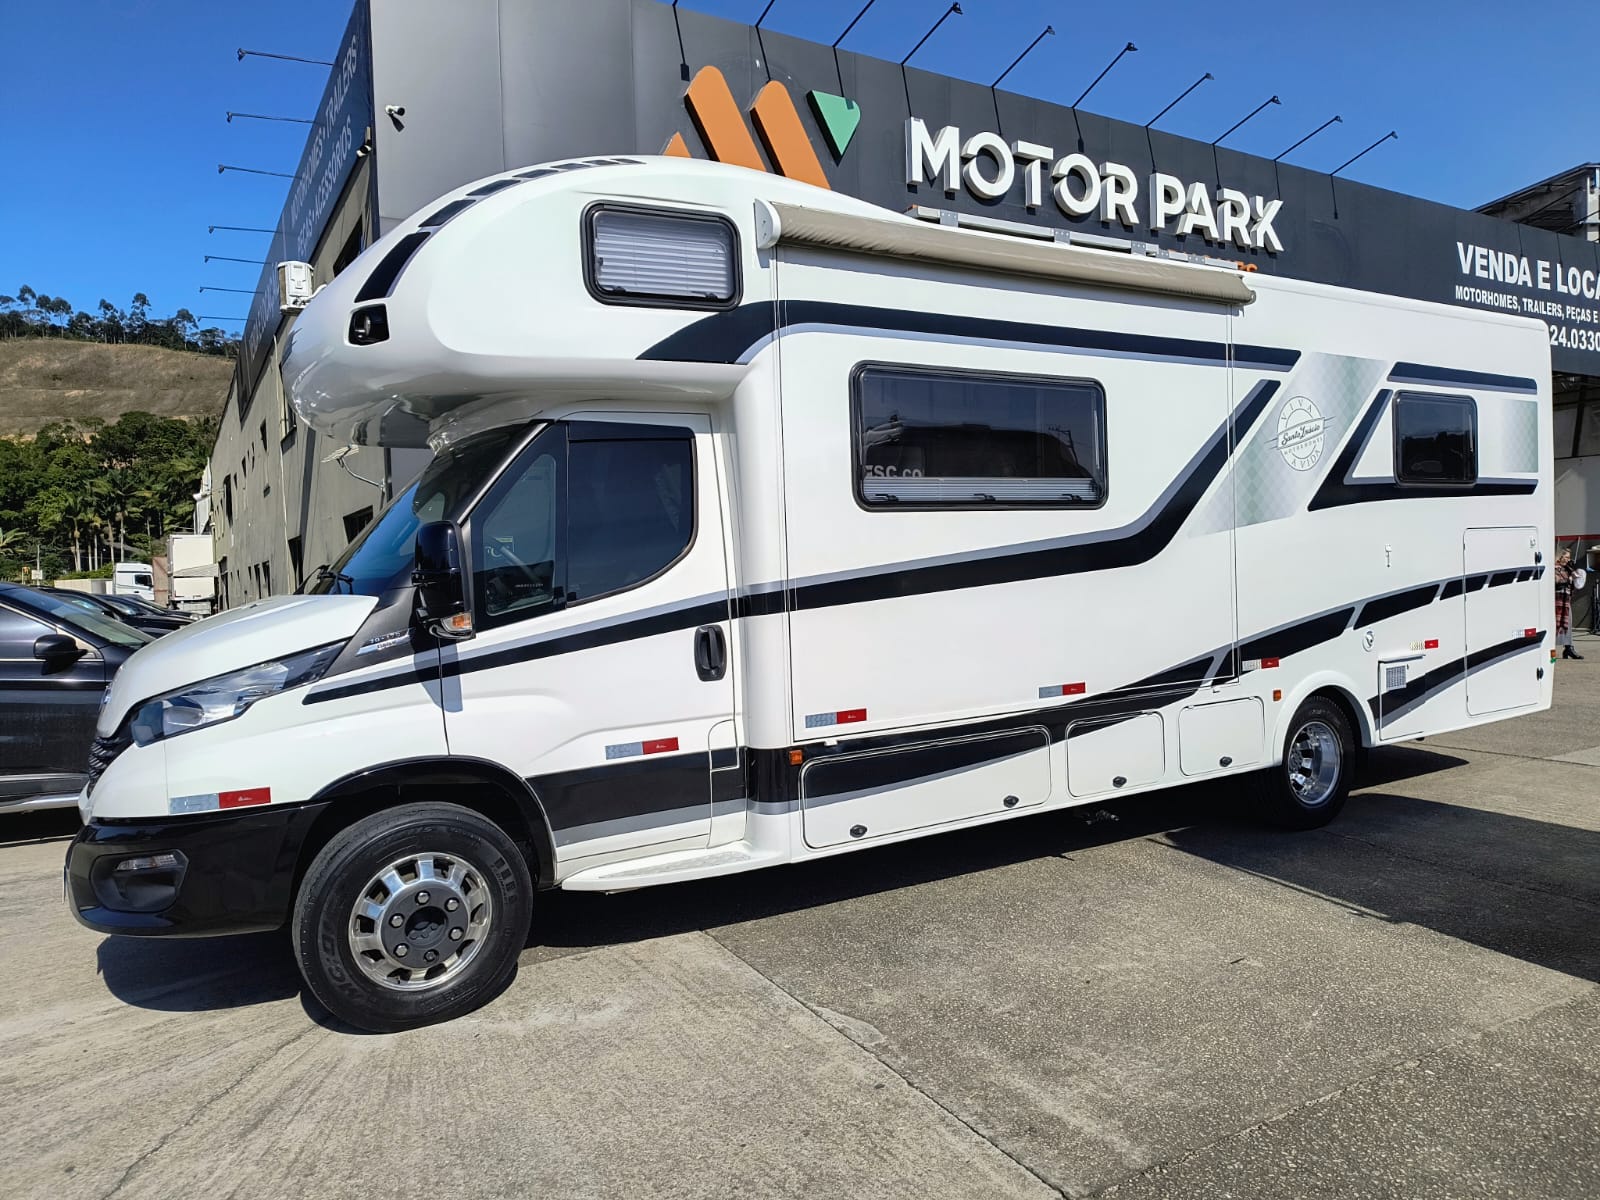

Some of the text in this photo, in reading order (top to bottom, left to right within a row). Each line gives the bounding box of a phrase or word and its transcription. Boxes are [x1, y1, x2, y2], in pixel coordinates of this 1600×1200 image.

[290, 34, 357, 228] MOTORHOMES TRAILERS
[905, 116, 1284, 253] MOTOR PARK
[1455, 285, 1599, 324] MOTORHOMES, TRAILERS, PEÇAS E
[1457, 241, 1533, 288] VENDA
[1537, 259, 1551, 290] E
